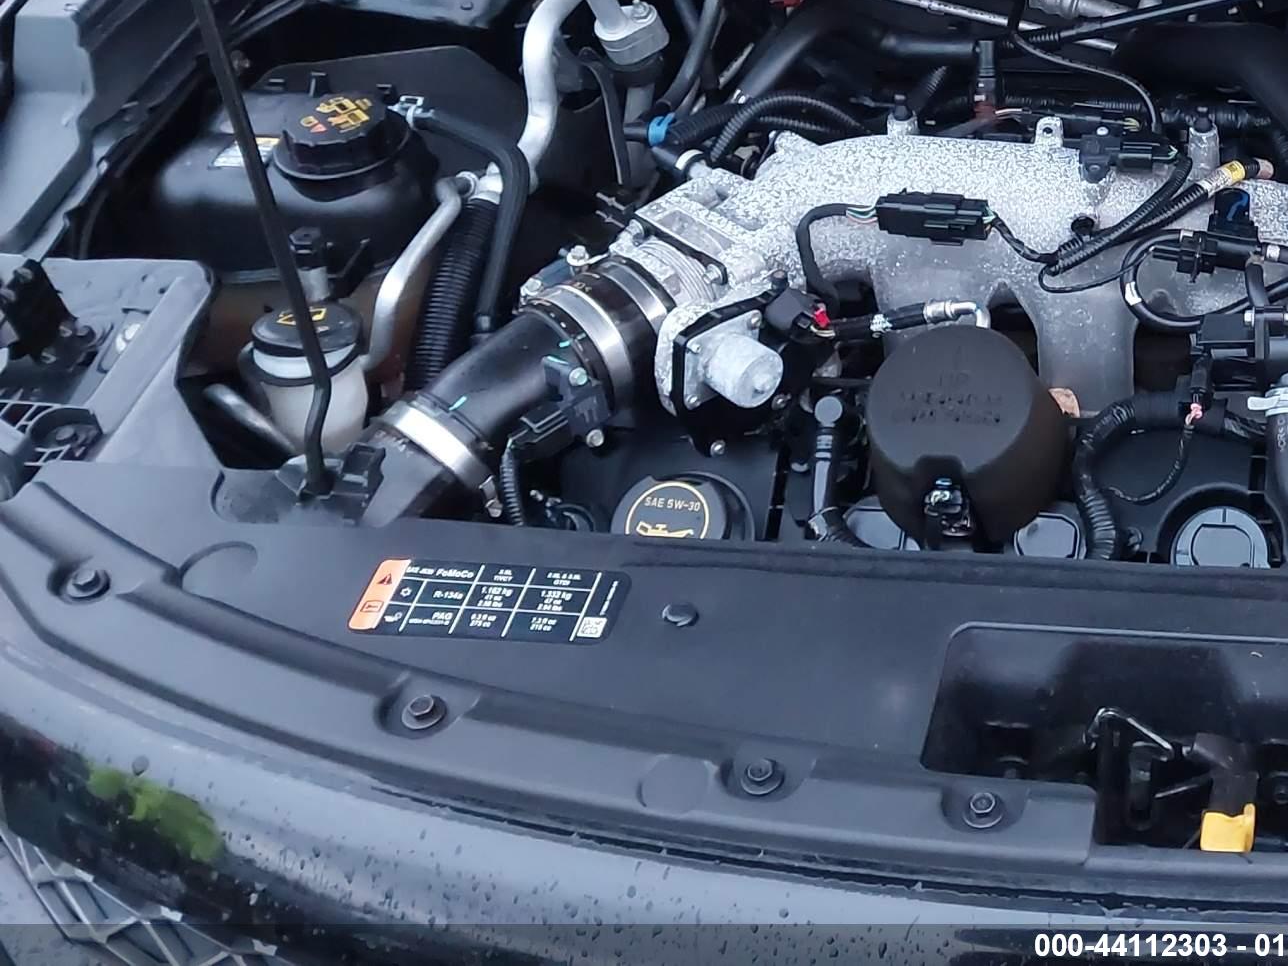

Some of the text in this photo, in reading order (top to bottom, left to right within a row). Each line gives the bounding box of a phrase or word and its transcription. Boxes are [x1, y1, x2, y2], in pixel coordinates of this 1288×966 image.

[644, 496, 701, 512] SAE 5W-30
[436, 568, 474, 579] FoMoCo
[433, 590, 464, 600] R-134a
